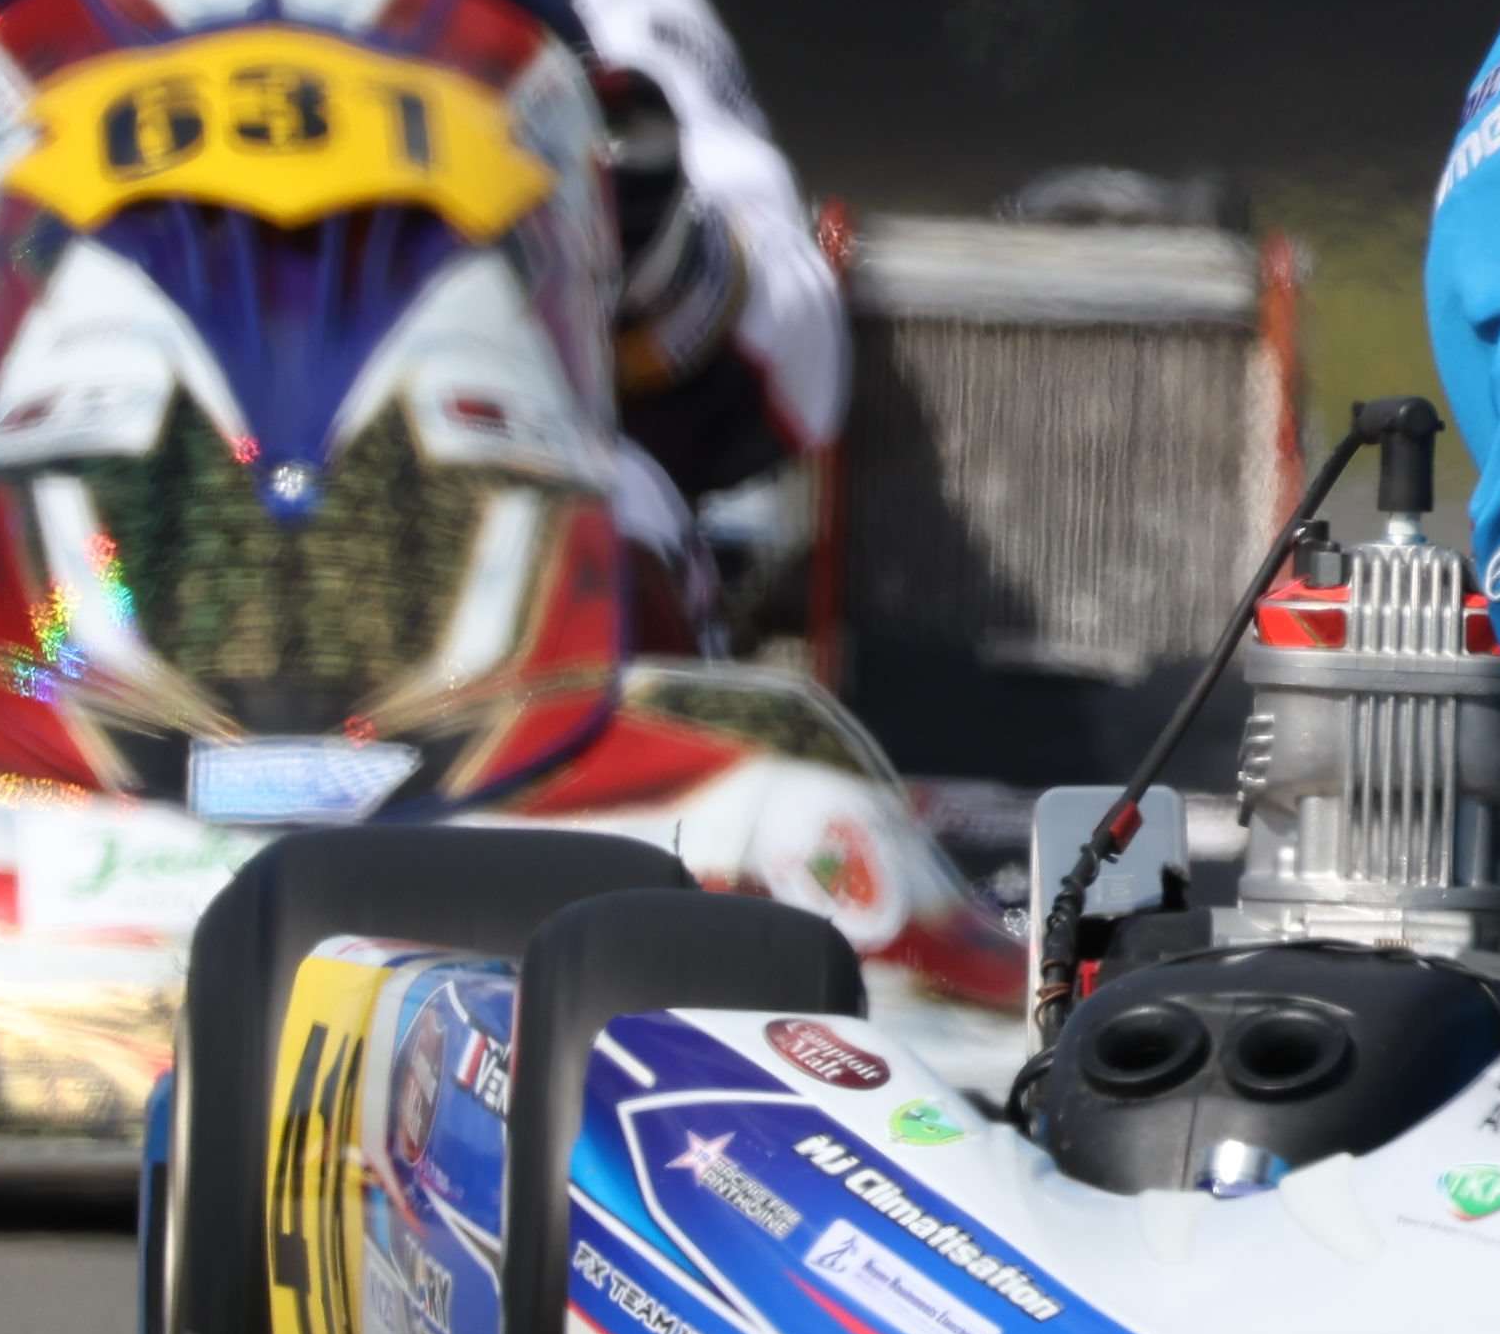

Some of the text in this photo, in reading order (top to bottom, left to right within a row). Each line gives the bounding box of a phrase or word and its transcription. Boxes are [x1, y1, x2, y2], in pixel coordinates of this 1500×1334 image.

[100, 66, 432, 182] 631
[792, 1133, 861, 1176] MJ
[843, 1167, 1063, 1323] Climatisation
